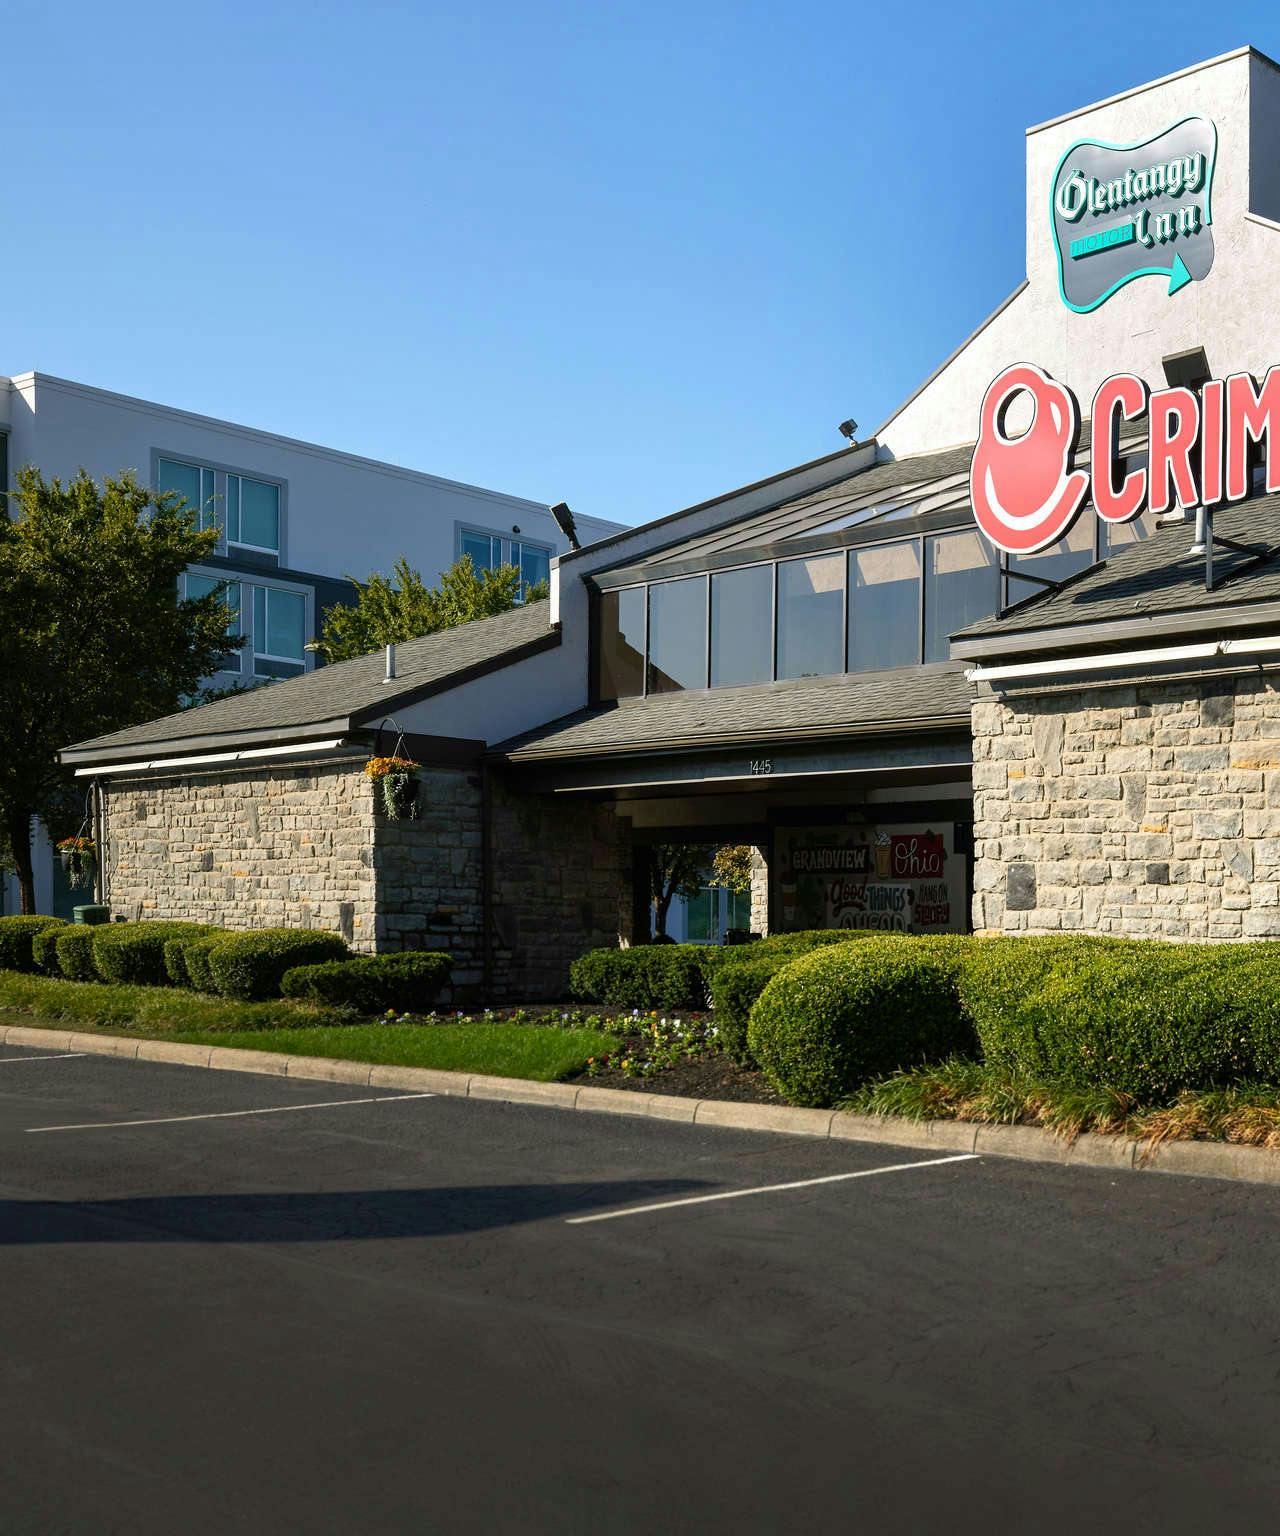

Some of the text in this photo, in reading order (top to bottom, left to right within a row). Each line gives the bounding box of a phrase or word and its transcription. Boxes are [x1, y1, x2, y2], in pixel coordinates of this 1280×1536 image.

[1056, 151, 1206, 222] Olentangy
[1134, 204, 1201, 247] Inn
[750, 759, 772, 775] 1445
[793, 848, 866, 871] GRANDVIEW
[894, 838, 940, 875] Ohio
